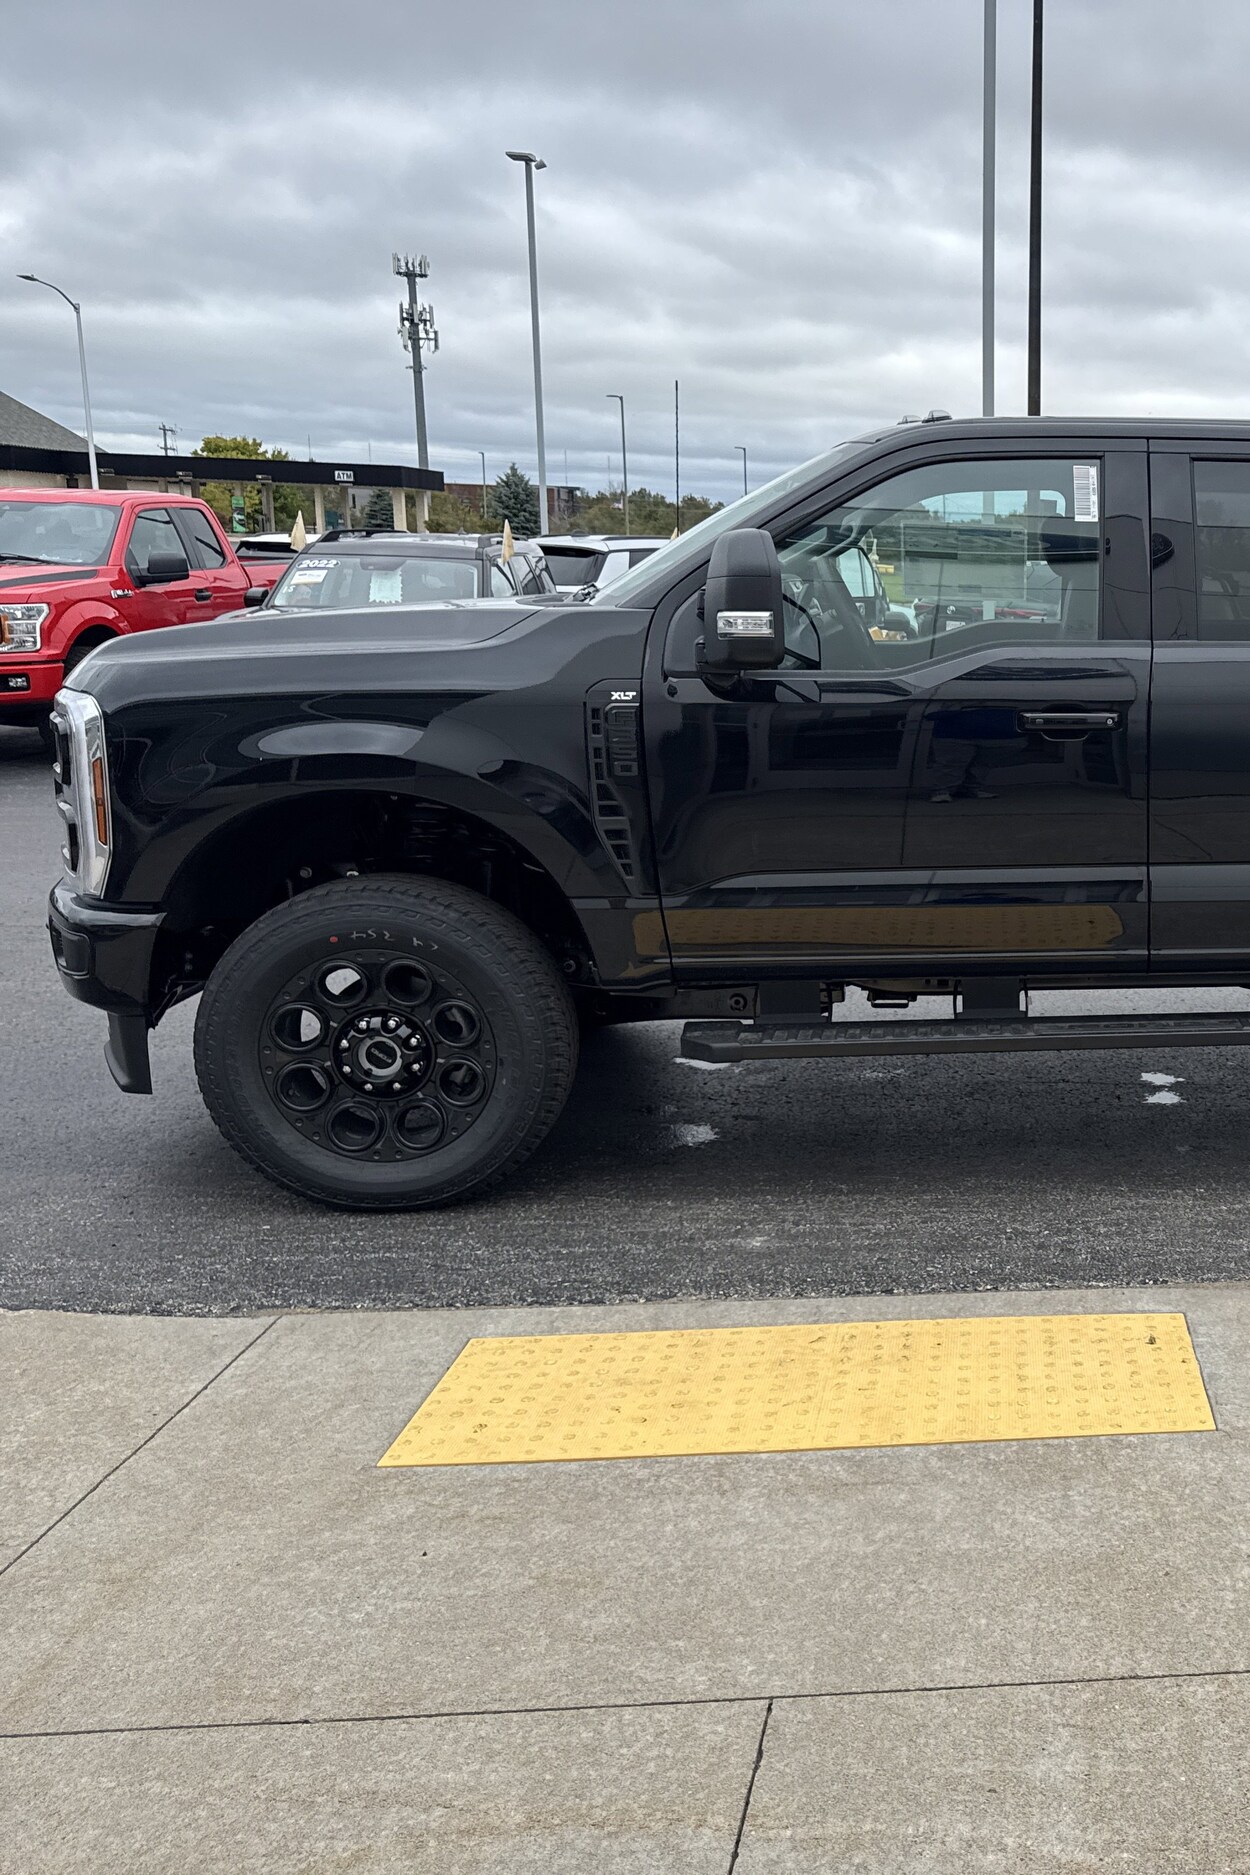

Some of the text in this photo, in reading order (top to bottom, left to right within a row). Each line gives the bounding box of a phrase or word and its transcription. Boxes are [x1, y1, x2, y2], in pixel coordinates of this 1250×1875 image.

[336, 471, 353, 480] ATM
[299, 559, 338, 568] 2022
[610, 691, 637, 700] XLT
